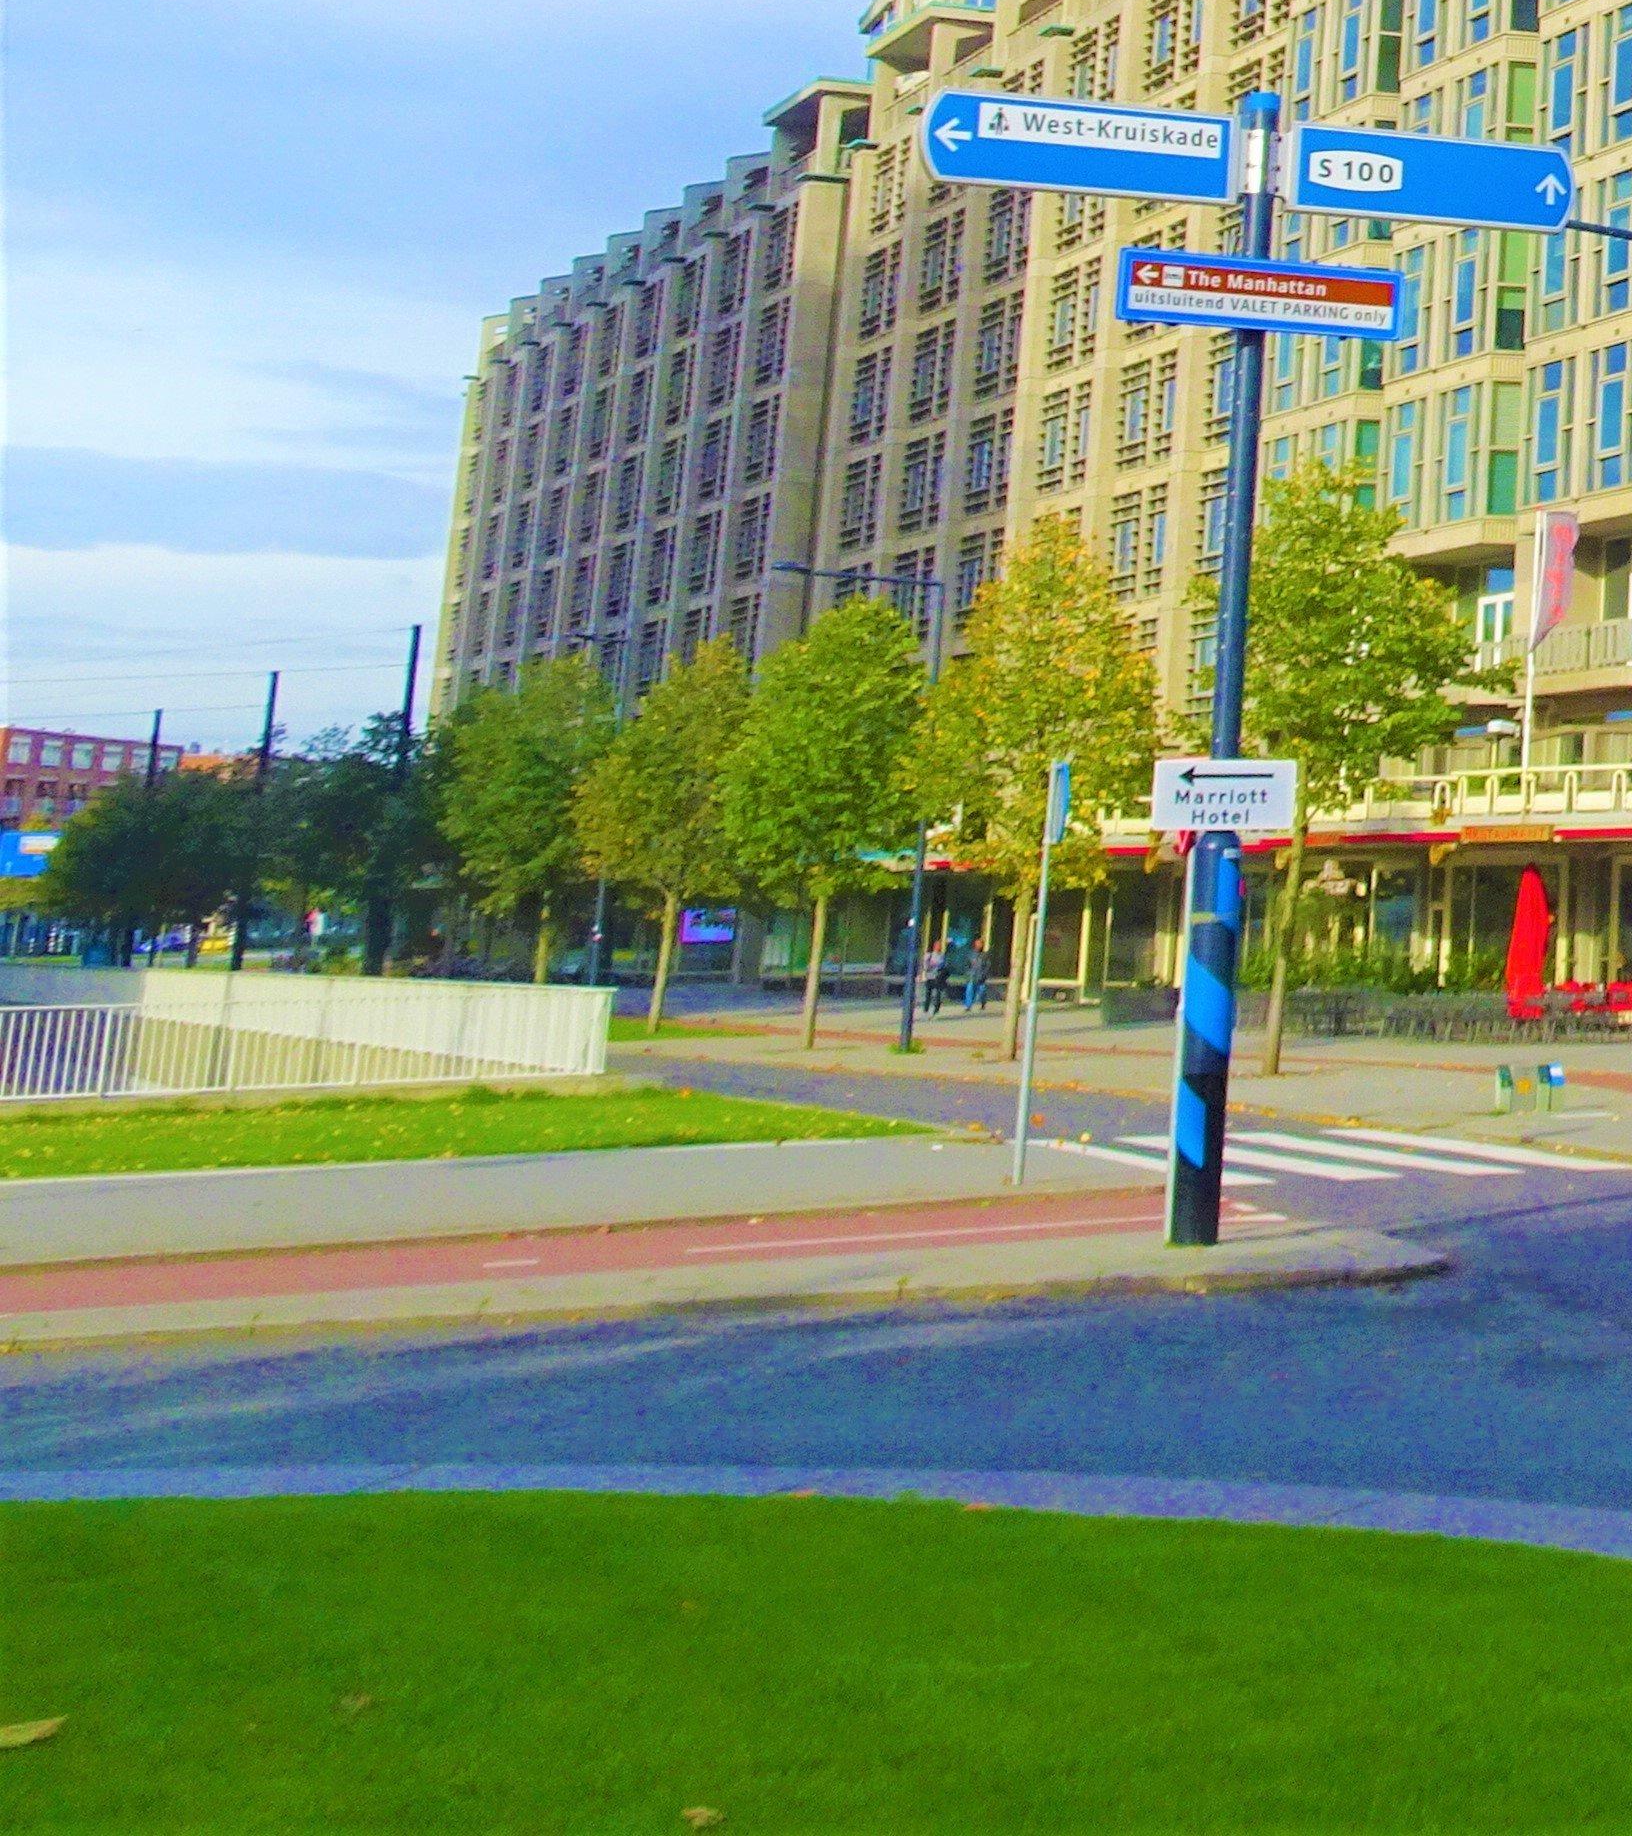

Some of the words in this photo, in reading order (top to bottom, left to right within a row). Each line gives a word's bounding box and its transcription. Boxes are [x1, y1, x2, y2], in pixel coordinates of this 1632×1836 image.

[1023, 112, 1218, 148] West-Kruiskade
[1318, 159, 1332, 178] S
[1343, 160, 1394, 183] 100
[1188, 270, 1222, 289] The
[1227, 274, 1327, 297] Manhattan
[1135, 290, 1224, 310] uitsluitend
[1231, 299, 1278, 314] VALET
[1283, 302, 1349, 320] PARKING
[1355, 310, 1388, 326] only
[1174, 789, 1269, 805] Marriott
[1191, 809, 1250, 825] Hotel
